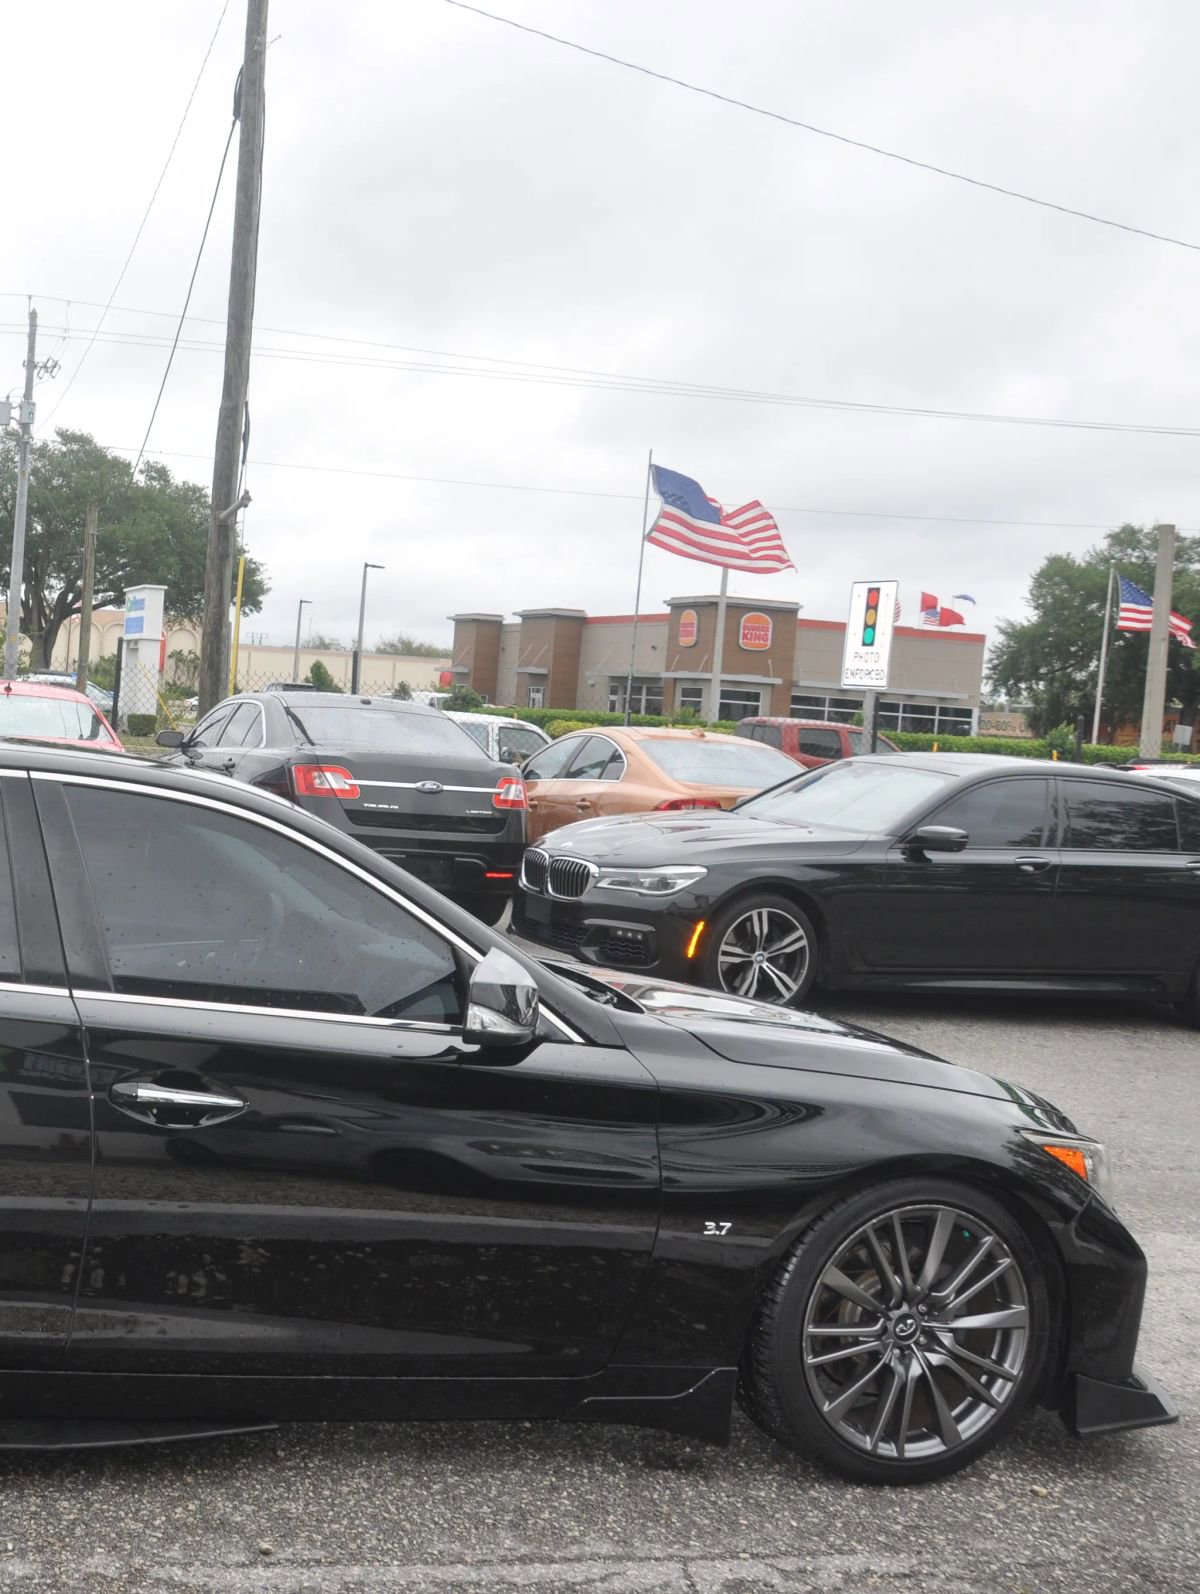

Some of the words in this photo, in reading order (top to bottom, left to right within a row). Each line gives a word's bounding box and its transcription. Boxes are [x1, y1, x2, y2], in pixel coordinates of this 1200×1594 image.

[742, 631, 769, 643] KING
[853, 651, 880, 664] PHOTO
[845, 668, 885, 681] ENFORCED
[703, 1221, 733, 1236] 3.7
